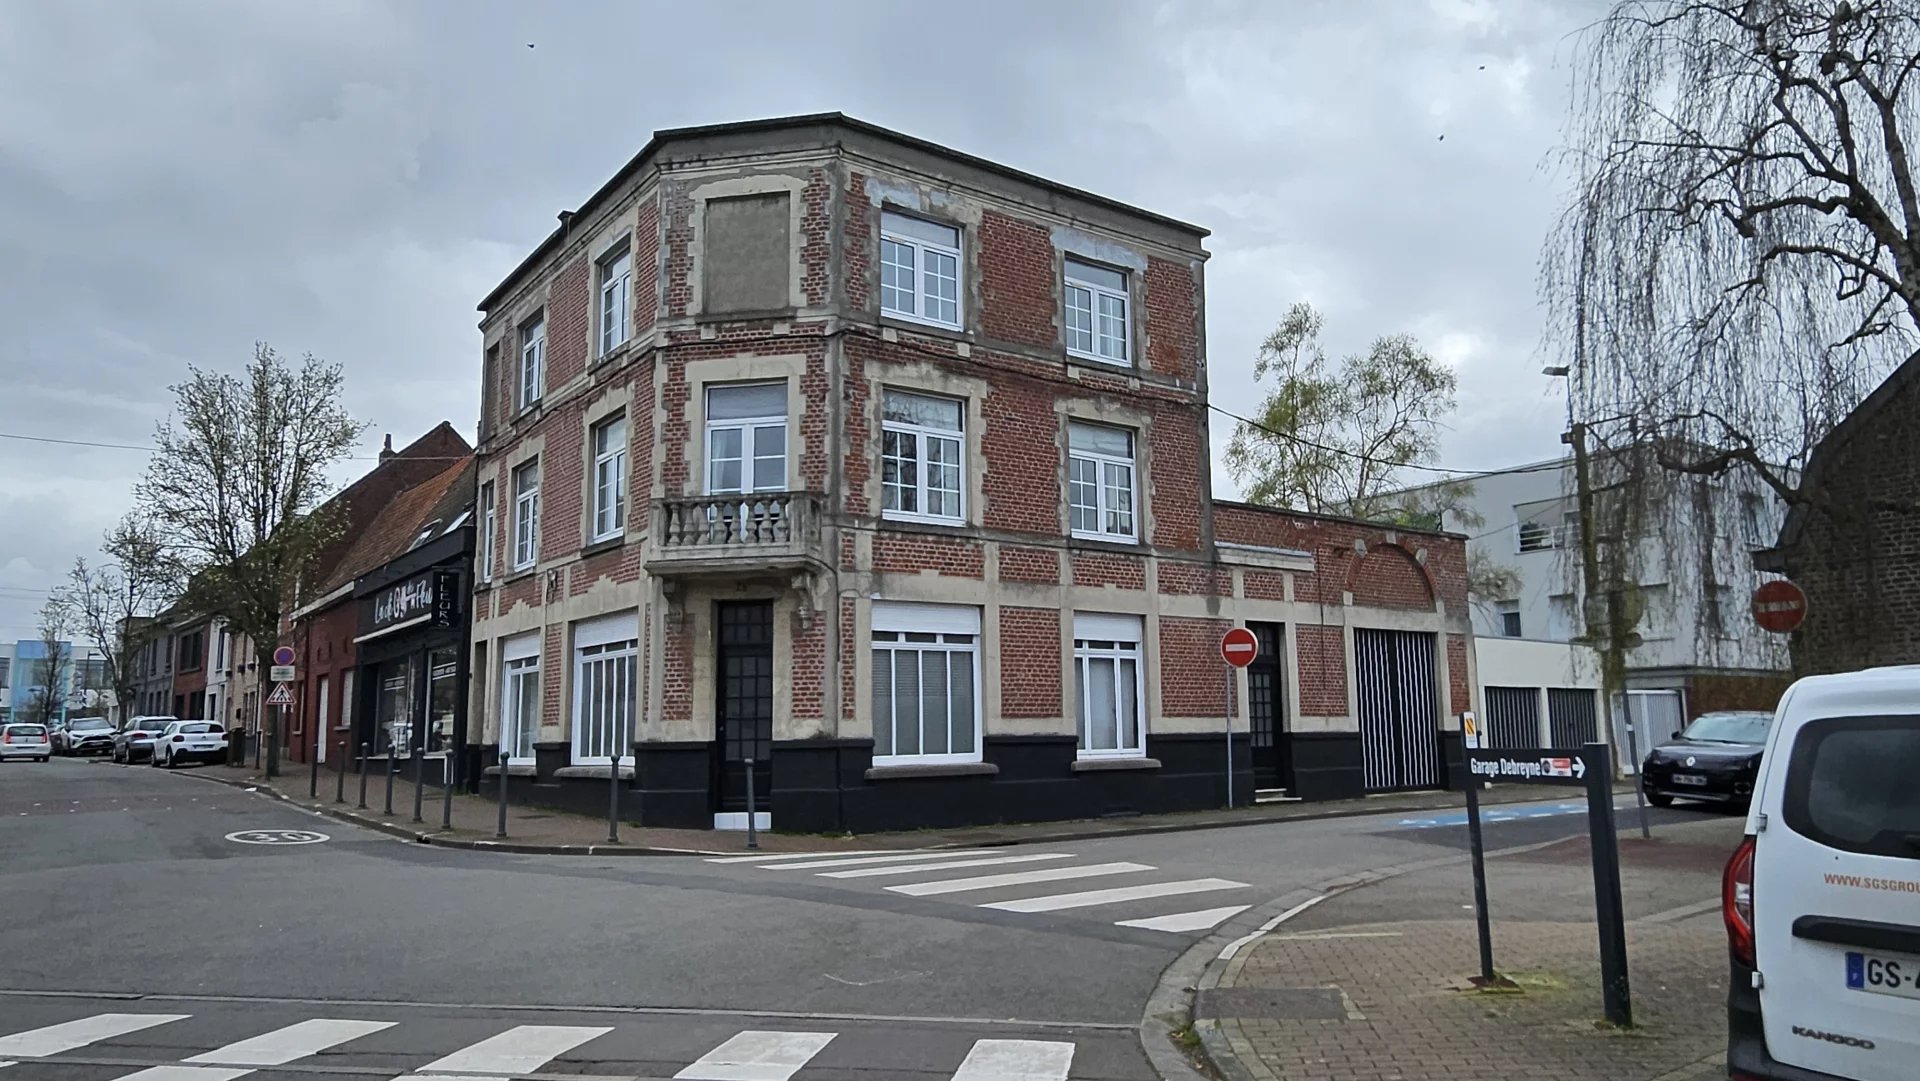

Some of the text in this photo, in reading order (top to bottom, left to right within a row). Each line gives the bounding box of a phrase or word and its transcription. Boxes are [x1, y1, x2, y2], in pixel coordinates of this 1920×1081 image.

[439, 575, 451, 627] FLEURS
[1470, 757, 1500, 778] Garage
[1500, 758, 1541, 779] Debreyne
[247, 832, 312, 842] 30
